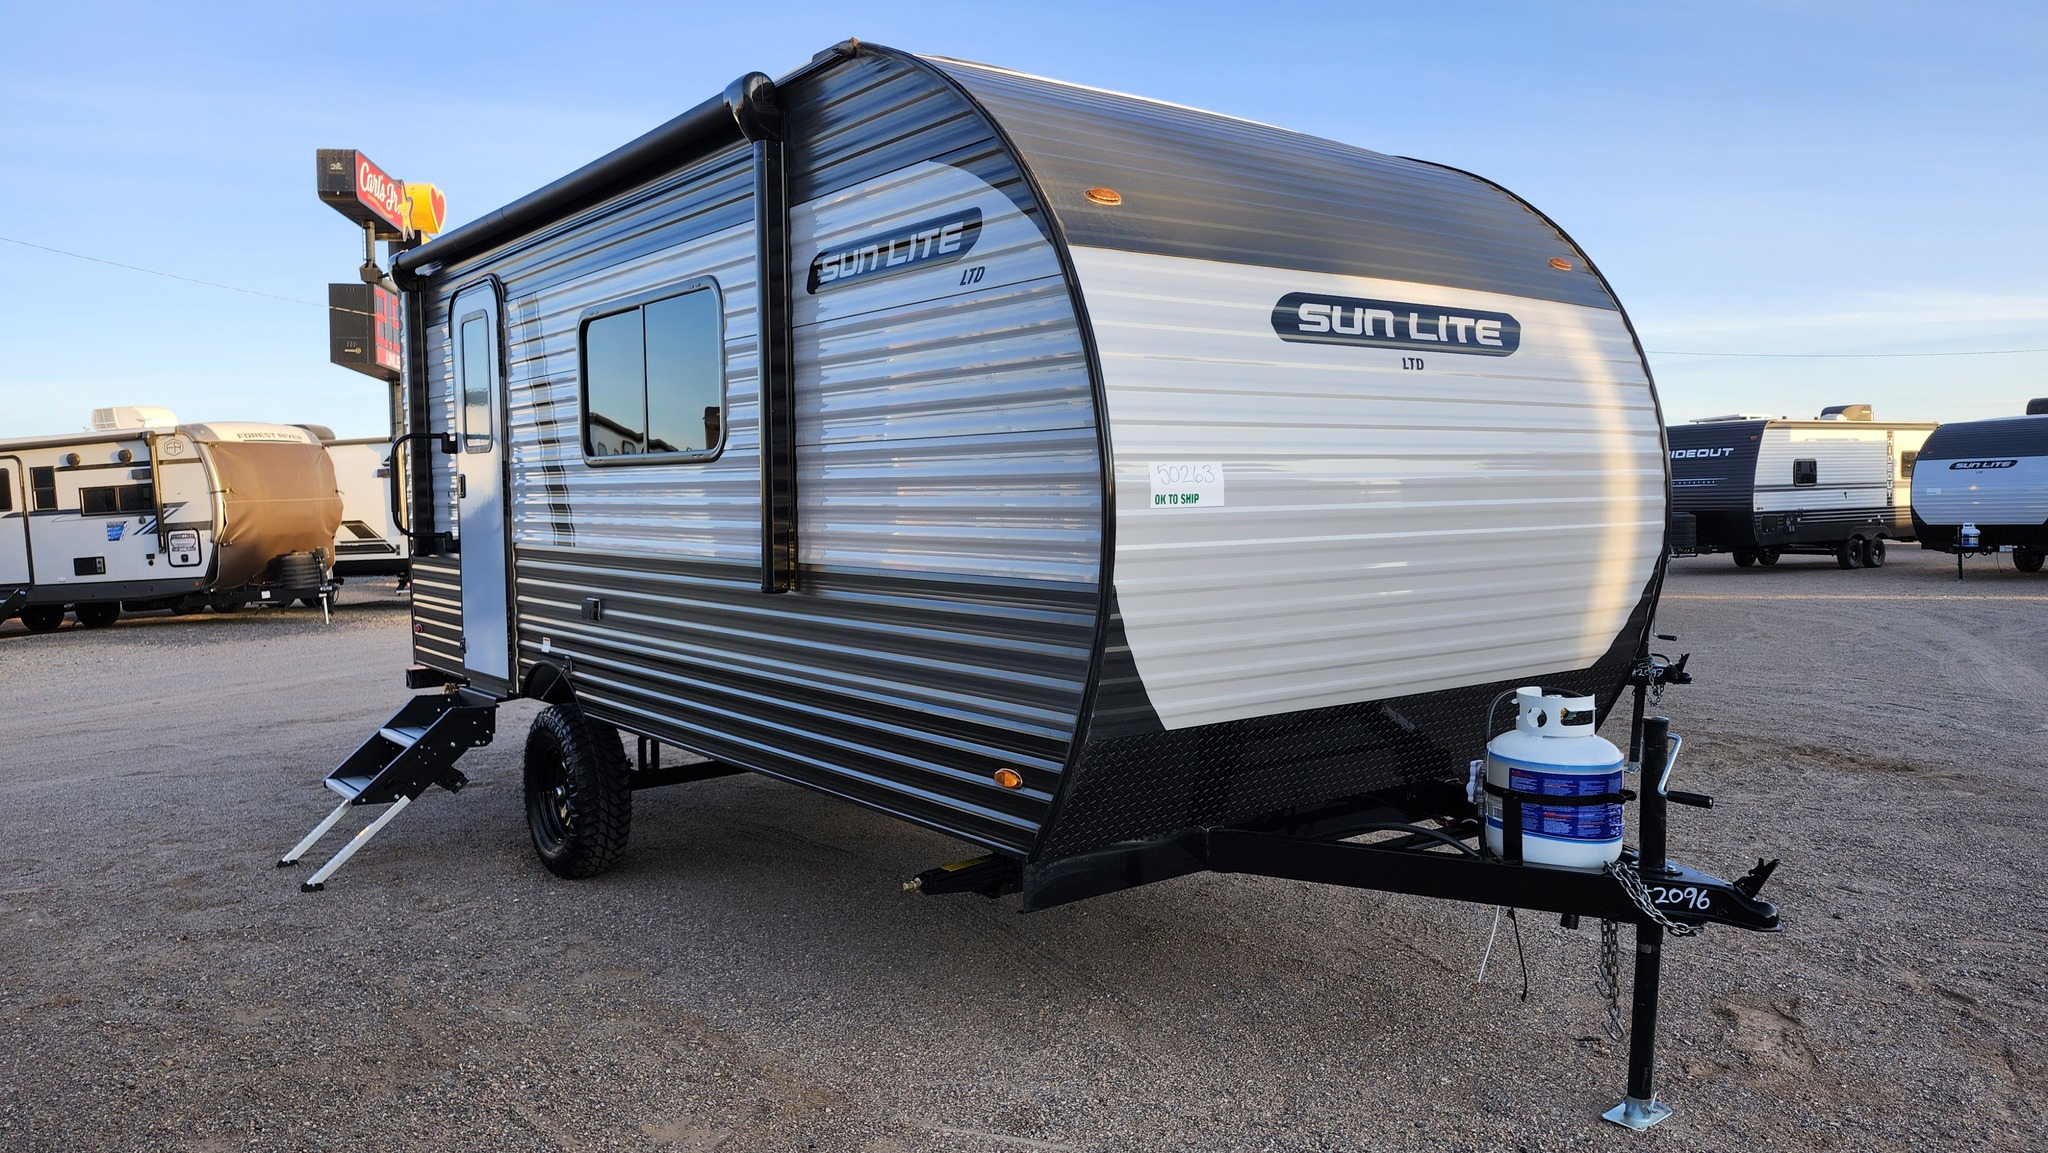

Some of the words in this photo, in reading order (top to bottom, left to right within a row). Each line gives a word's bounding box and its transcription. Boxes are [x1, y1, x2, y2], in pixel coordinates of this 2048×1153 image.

[360, 161, 387, 203] Carl's
[820, 244, 879, 284] SUN
[886, 221, 964, 268] LITE
[959, 265, 986, 287] LTD
[1297, 302, 1396, 339] SUN
[1408, 312, 1504, 347] LITE
[1402, 357, 1425, 371] LTD
[236, 432, 276, 440] FOREST
[277, 433, 304, 441] RIVER
[1669, 448, 1734, 459] IDEOUT
[1954, 461, 1981, 469] SUN
[1156, 464, 1215, 485] 50263
[1154, 493, 1167, 505] OK
[1168, 493, 1179, 505] TO
[1180, 493, 1200, 505] SHIP
